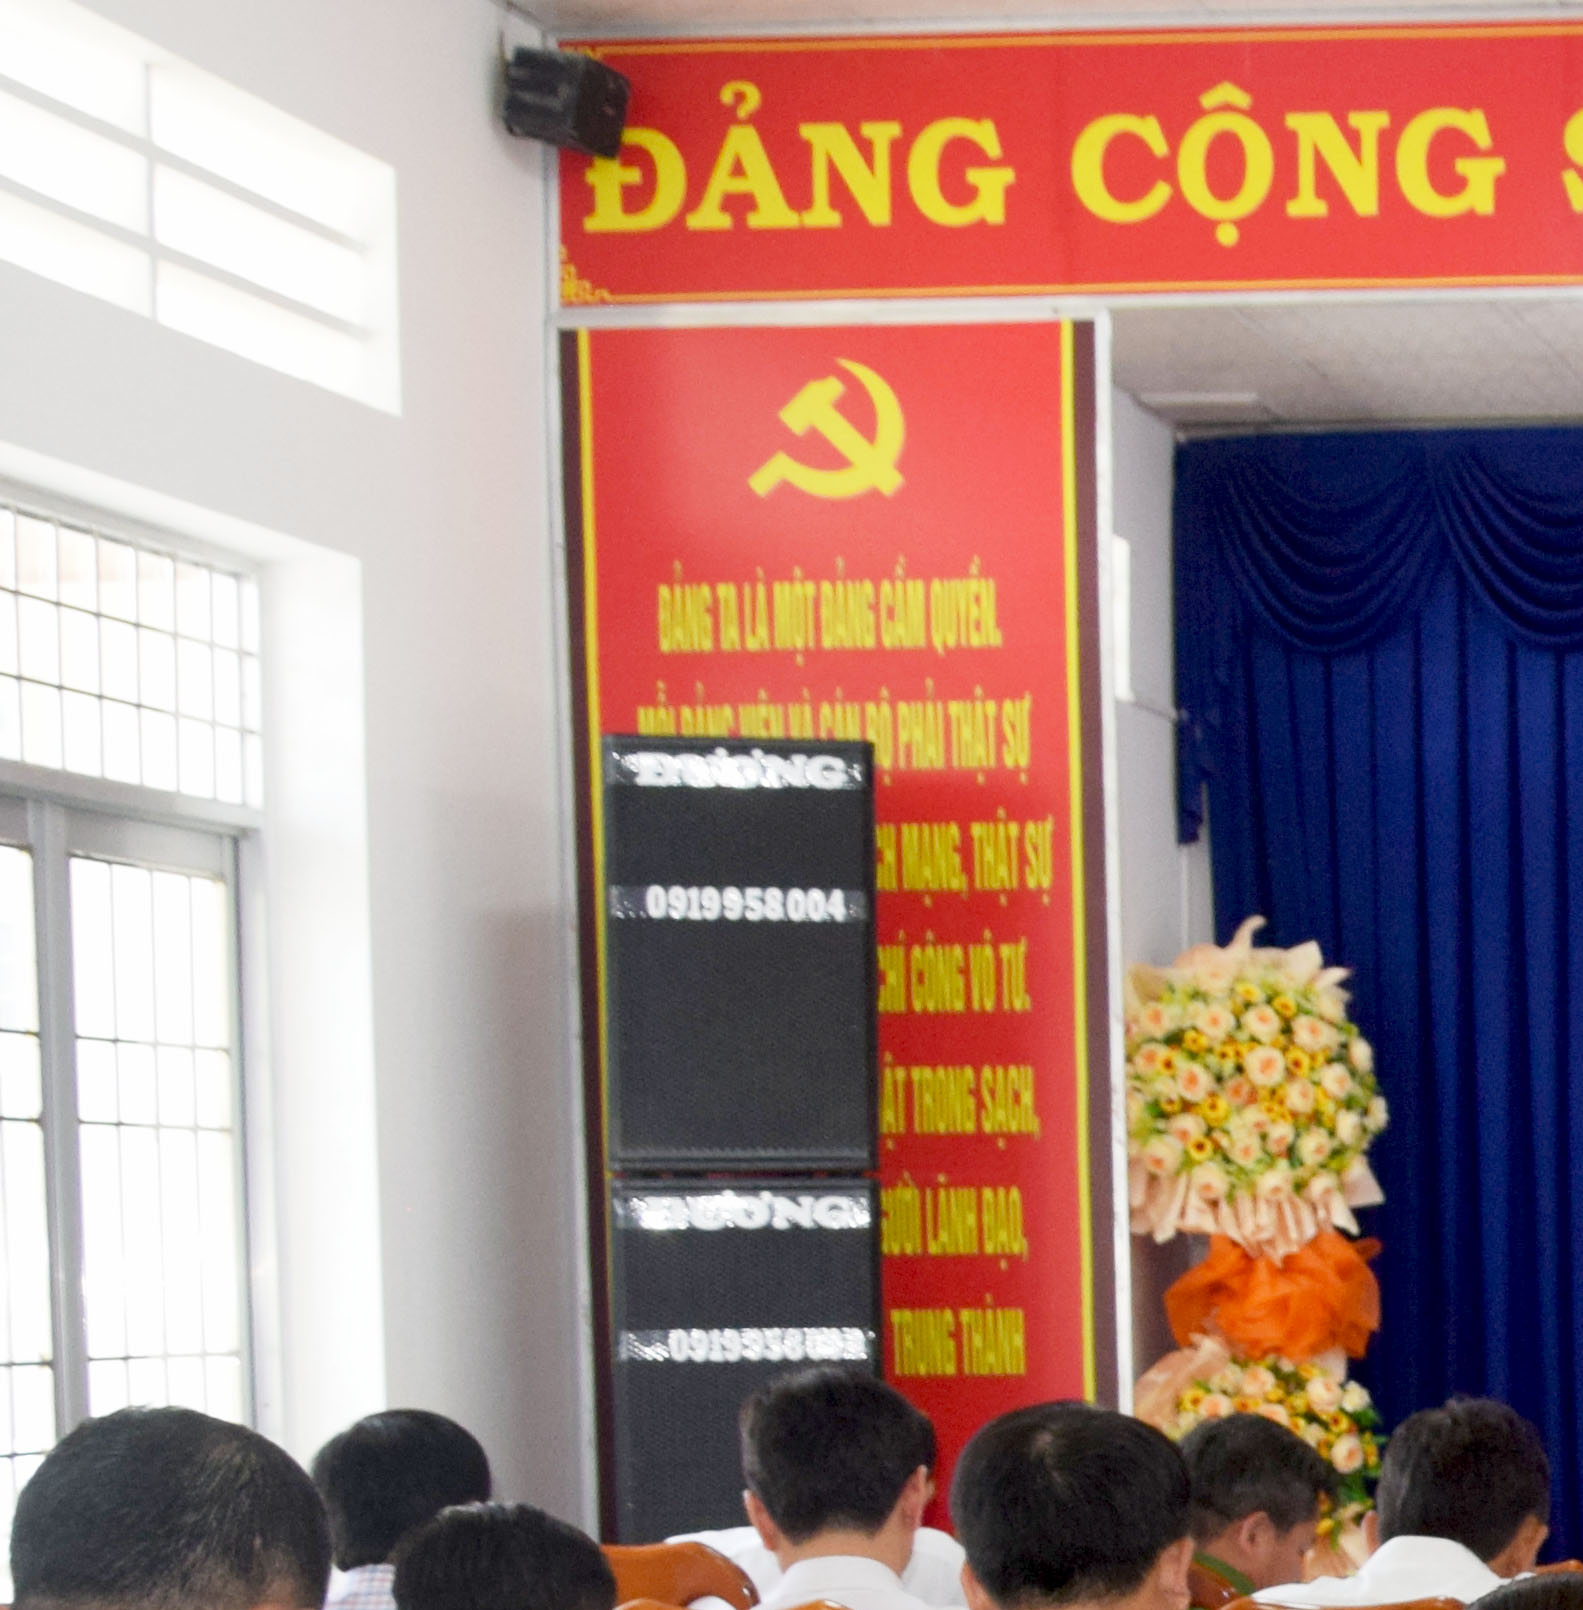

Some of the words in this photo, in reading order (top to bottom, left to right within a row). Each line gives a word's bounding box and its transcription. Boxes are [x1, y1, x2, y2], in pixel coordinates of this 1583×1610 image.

[584, 82, 1015, 231] ĐẢNG
[1072, 82, 1505, 246] CỘNG
[716, 582, 741, 651] TA
[743, 566, 769, 651] LÀ
[773, 565, 815, 667] MỘT
[897, 677, 945, 770] PHẢI
[948, 684, 997, 785] THẬT
[1002, 691, 1031, 785] SỰ
[646, 884, 846, 921] 0919958004
[911, 930, 965, 1012] CÔNG
[969, 928, 996, 1012] VÔ
